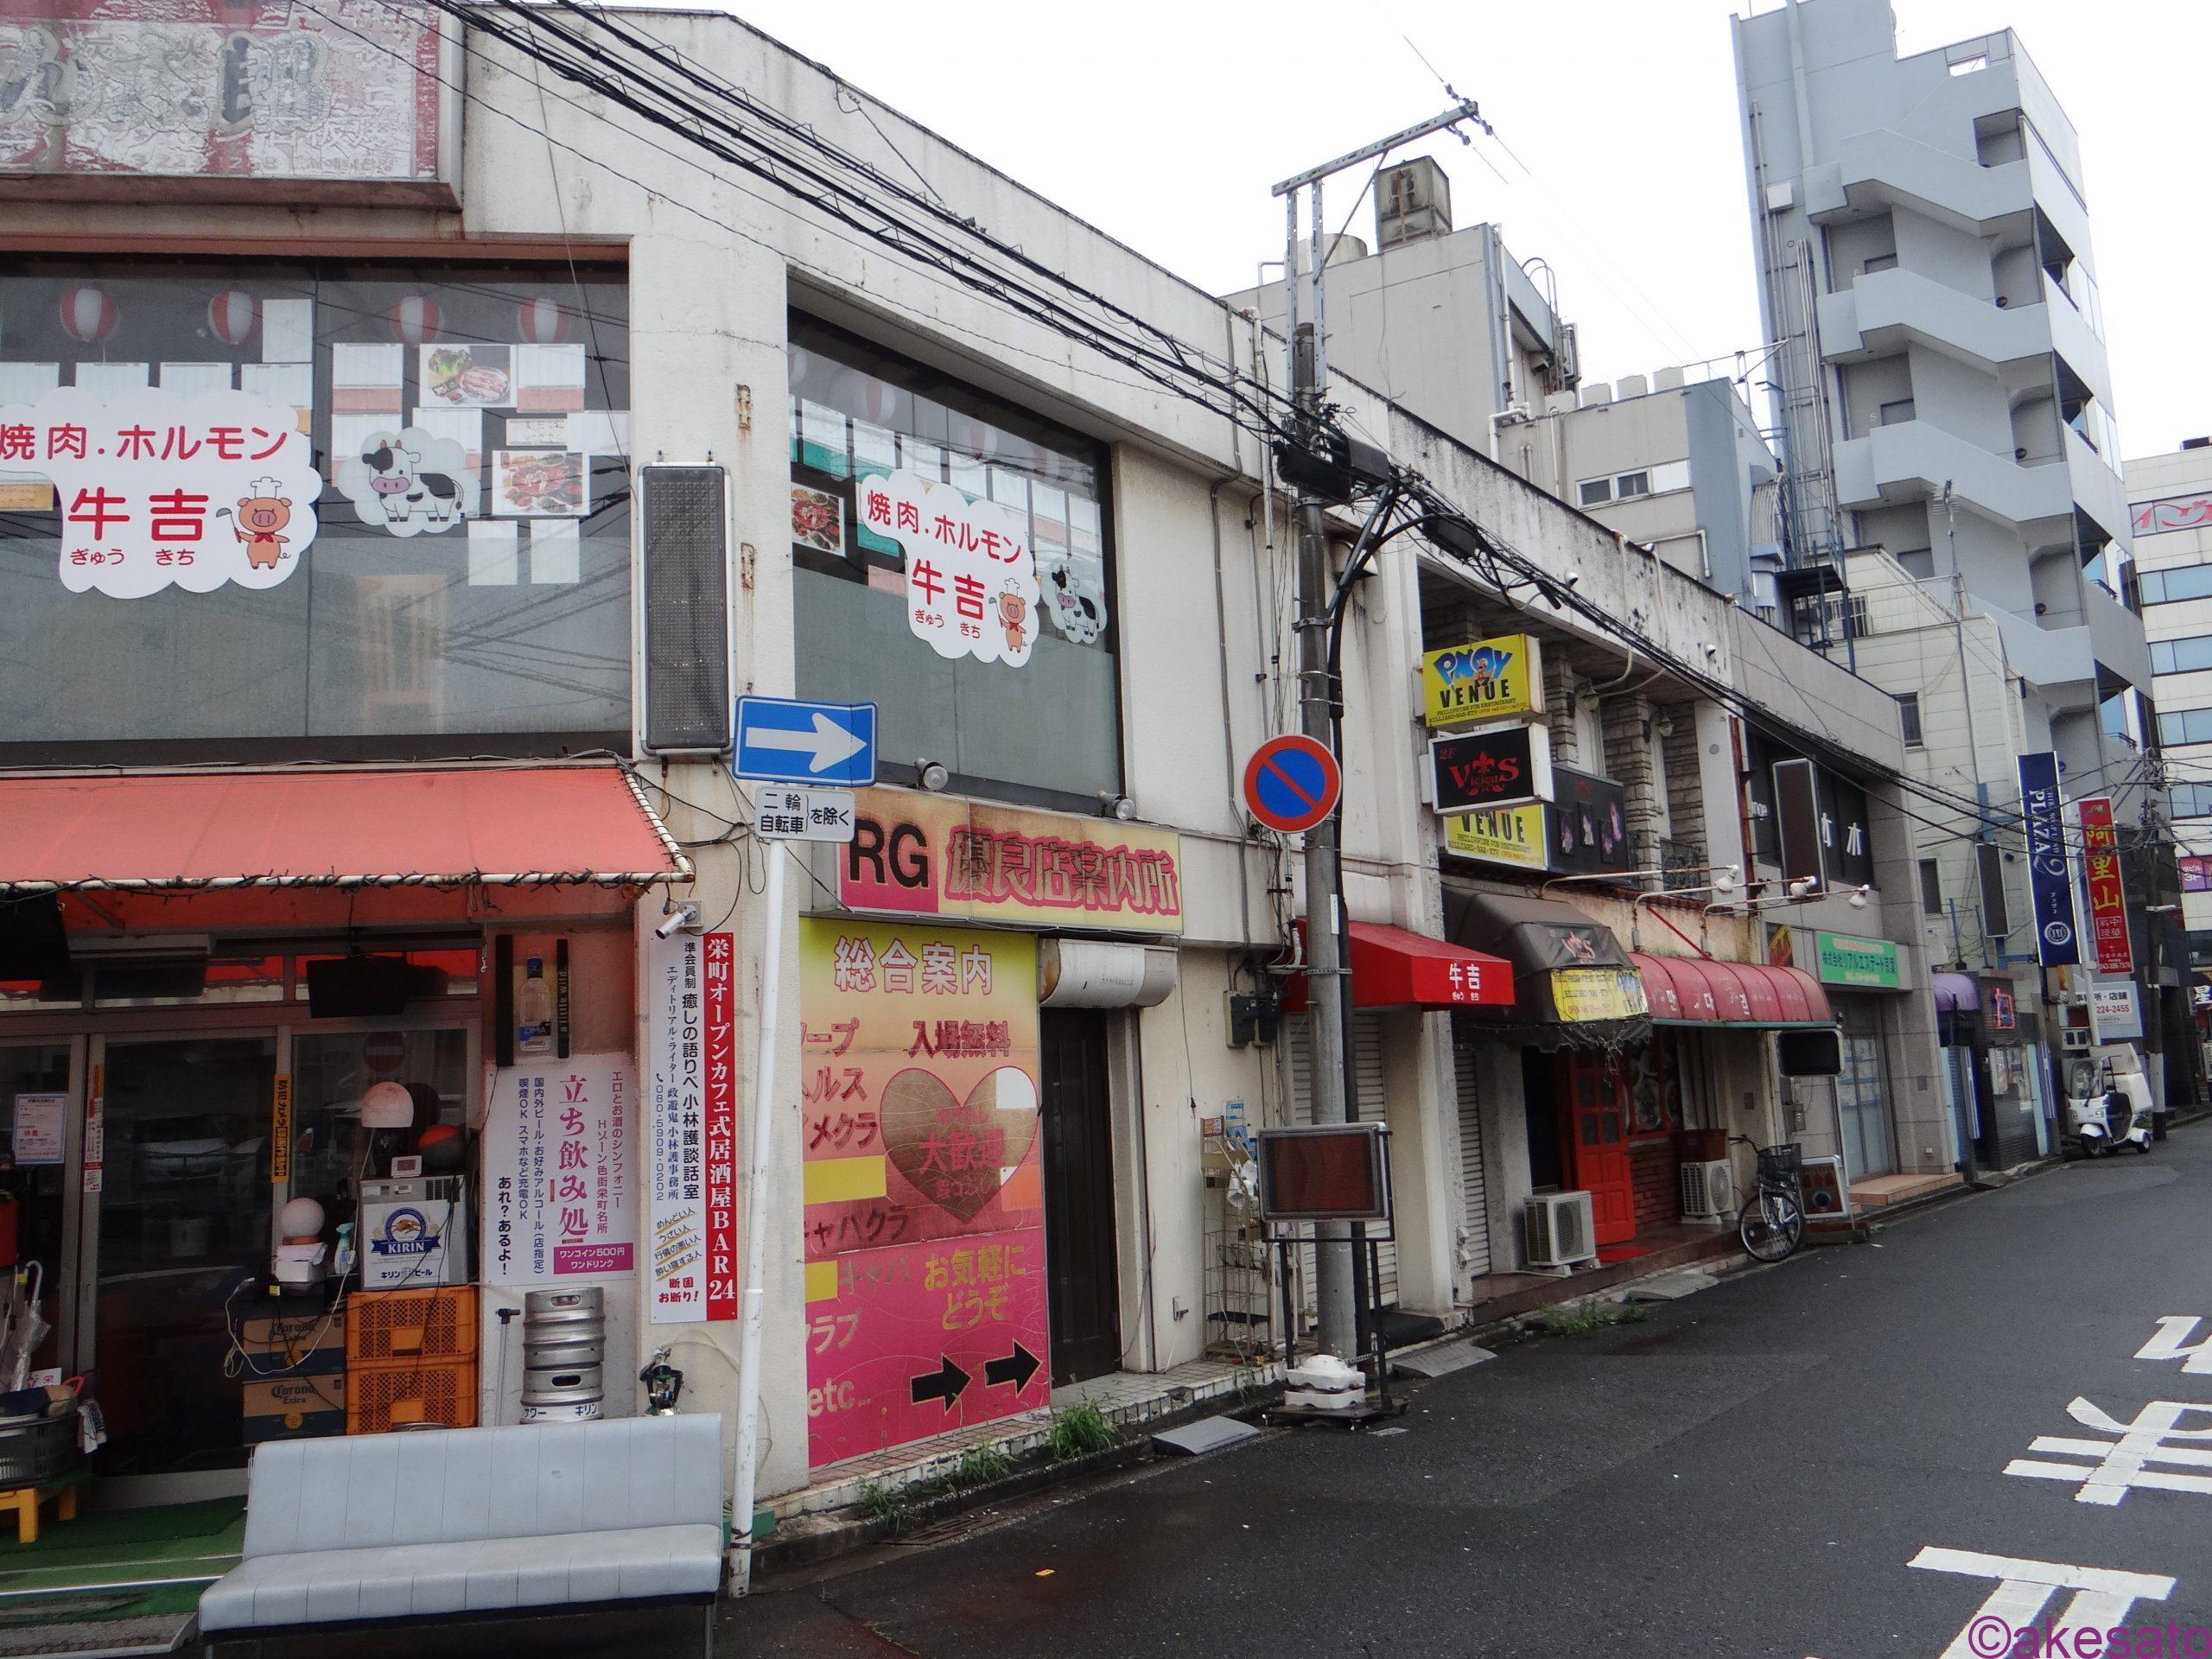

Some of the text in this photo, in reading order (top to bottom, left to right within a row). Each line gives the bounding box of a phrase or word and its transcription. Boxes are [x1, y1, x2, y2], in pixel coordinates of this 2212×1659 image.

[68, 487, 209, 542] 牛吉
[70, 548, 195, 567] ぎゅう きち
[911, 557, 985, 620] 牛吉
[914, 608, 982, 639] ぎゅう きち
[1440, 678, 1510, 709] VENUE
[764, 792, 802, 812] 二輪
[810, 806, 850, 827] を除く
[760, 813, 804, 835] 自転車
[1460, 810, 1525, 844] VENUE
[848, 818, 931, 890] RG
[947, 827, 1179, 913] 優良店案内所
[2086, 823, 2121, 911] 阿里山
[833, 935, 993, 996] 総合案内
[1449, 963, 1481, 990] 牛吉
[666, 965, 678, 1084] エディトリアル・ライター
[2096, 1004, 2130, 1014] 224-2455
[907, 1020, 1012, 1059] 入場無料
[682, 941, 700, 1200] 準会員制 癒しの語りべ 小林護談話室
[612, 1071, 624, 1209] エロとお酒のシンフォニー
[708, 938, 735, 1300] 栄町オープンカフェ式居酒屋BAR24
[518, 1125, 529, 1221] スマホなど充電OK
[558, 1074, 589, 1237] 立ち飲み処
[667, 1125, 680, 1200] 小林護事務所
[916, 1127, 1007, 1176] 大歓迎
[656, 1206, 696, 1230] めんどい人
[387, 1241, 425, 1255] KIRIN
[570, 1258, 614, 1270] ワンドリンク
[924, 1244, 1027, 1292] お気軽に
[380, 1269, 402, 1280] キリン
[941, 1284, 1011, 1332] どうぞ
[270, 1382, 315, 1398] Corona
[574, 1402, 598, 1416] キリン
